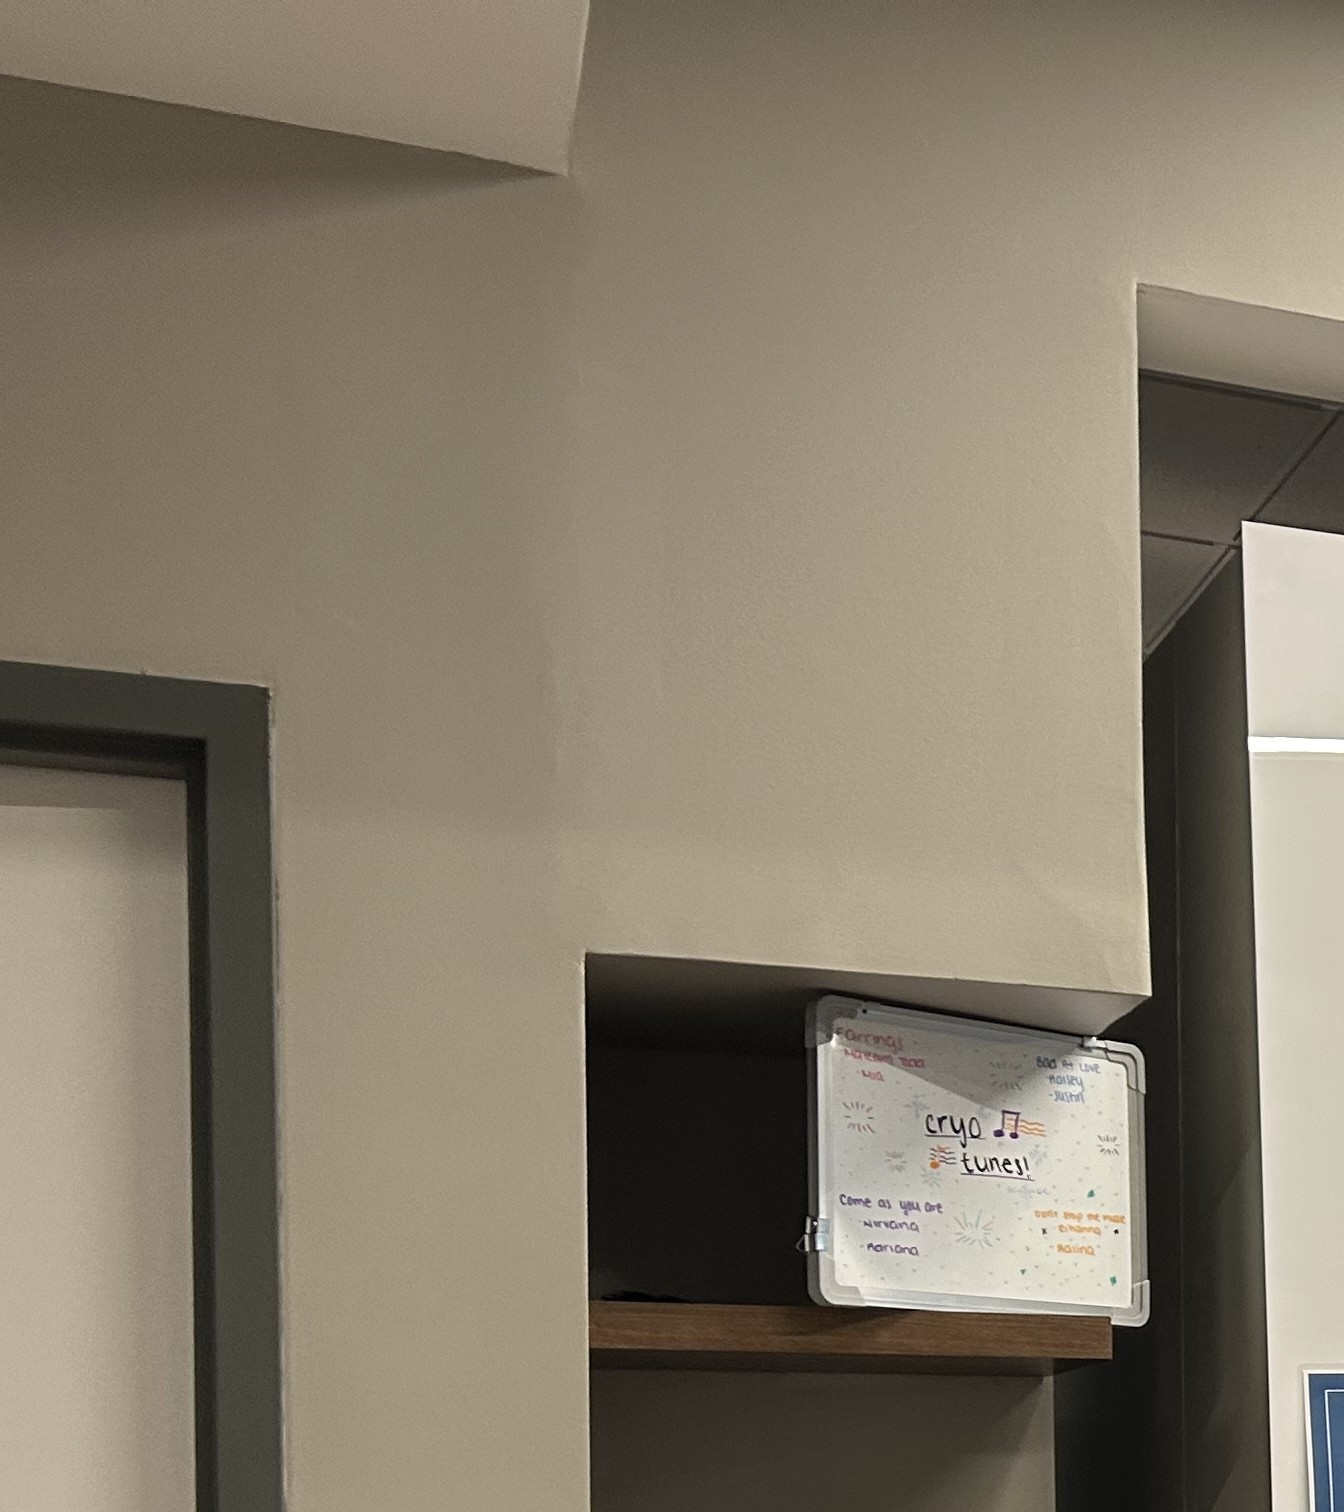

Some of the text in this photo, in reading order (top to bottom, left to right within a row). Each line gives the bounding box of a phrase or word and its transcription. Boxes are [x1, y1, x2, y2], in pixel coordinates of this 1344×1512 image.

[926, 1114, 981, 1148] cryo
[960, 1152, 1031, 1180] tunes!
[877, 1198, 892, 1210] as
[899, 1200, 921, 1216] you
